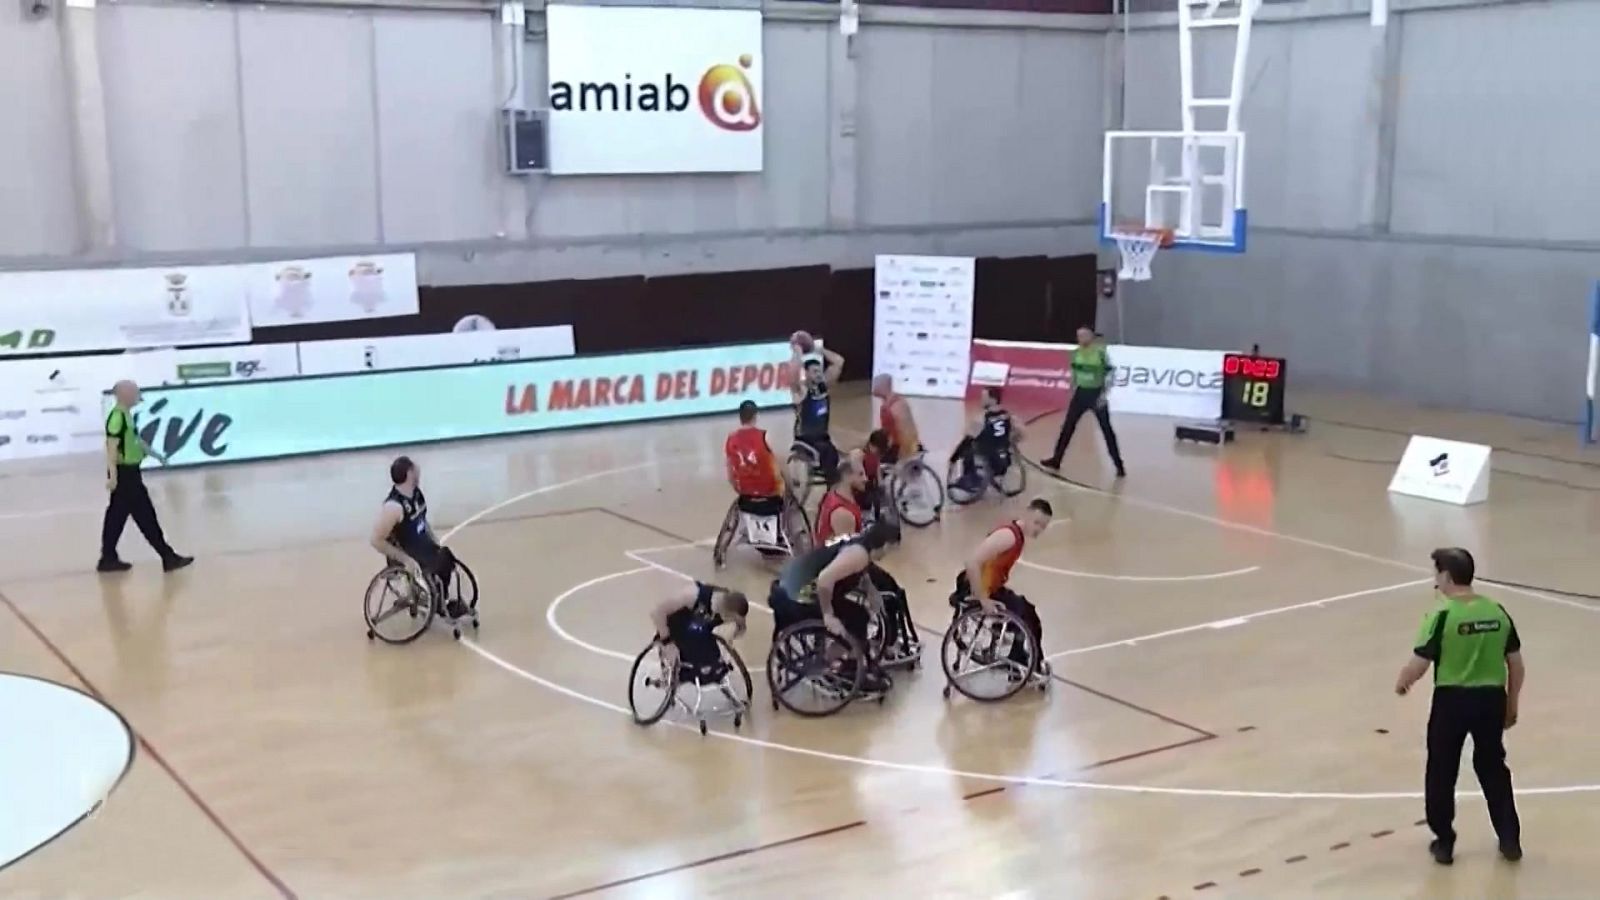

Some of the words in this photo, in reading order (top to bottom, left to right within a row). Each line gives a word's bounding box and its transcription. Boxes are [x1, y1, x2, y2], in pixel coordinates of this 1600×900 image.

[549, 73, 690, 112] amiab
[506, 383, 537, 415] LA
[548, 374, 645, 411] MARCA
[655, 370, 700, 400] DEL
[1242, 381, 1270, 407] 18
